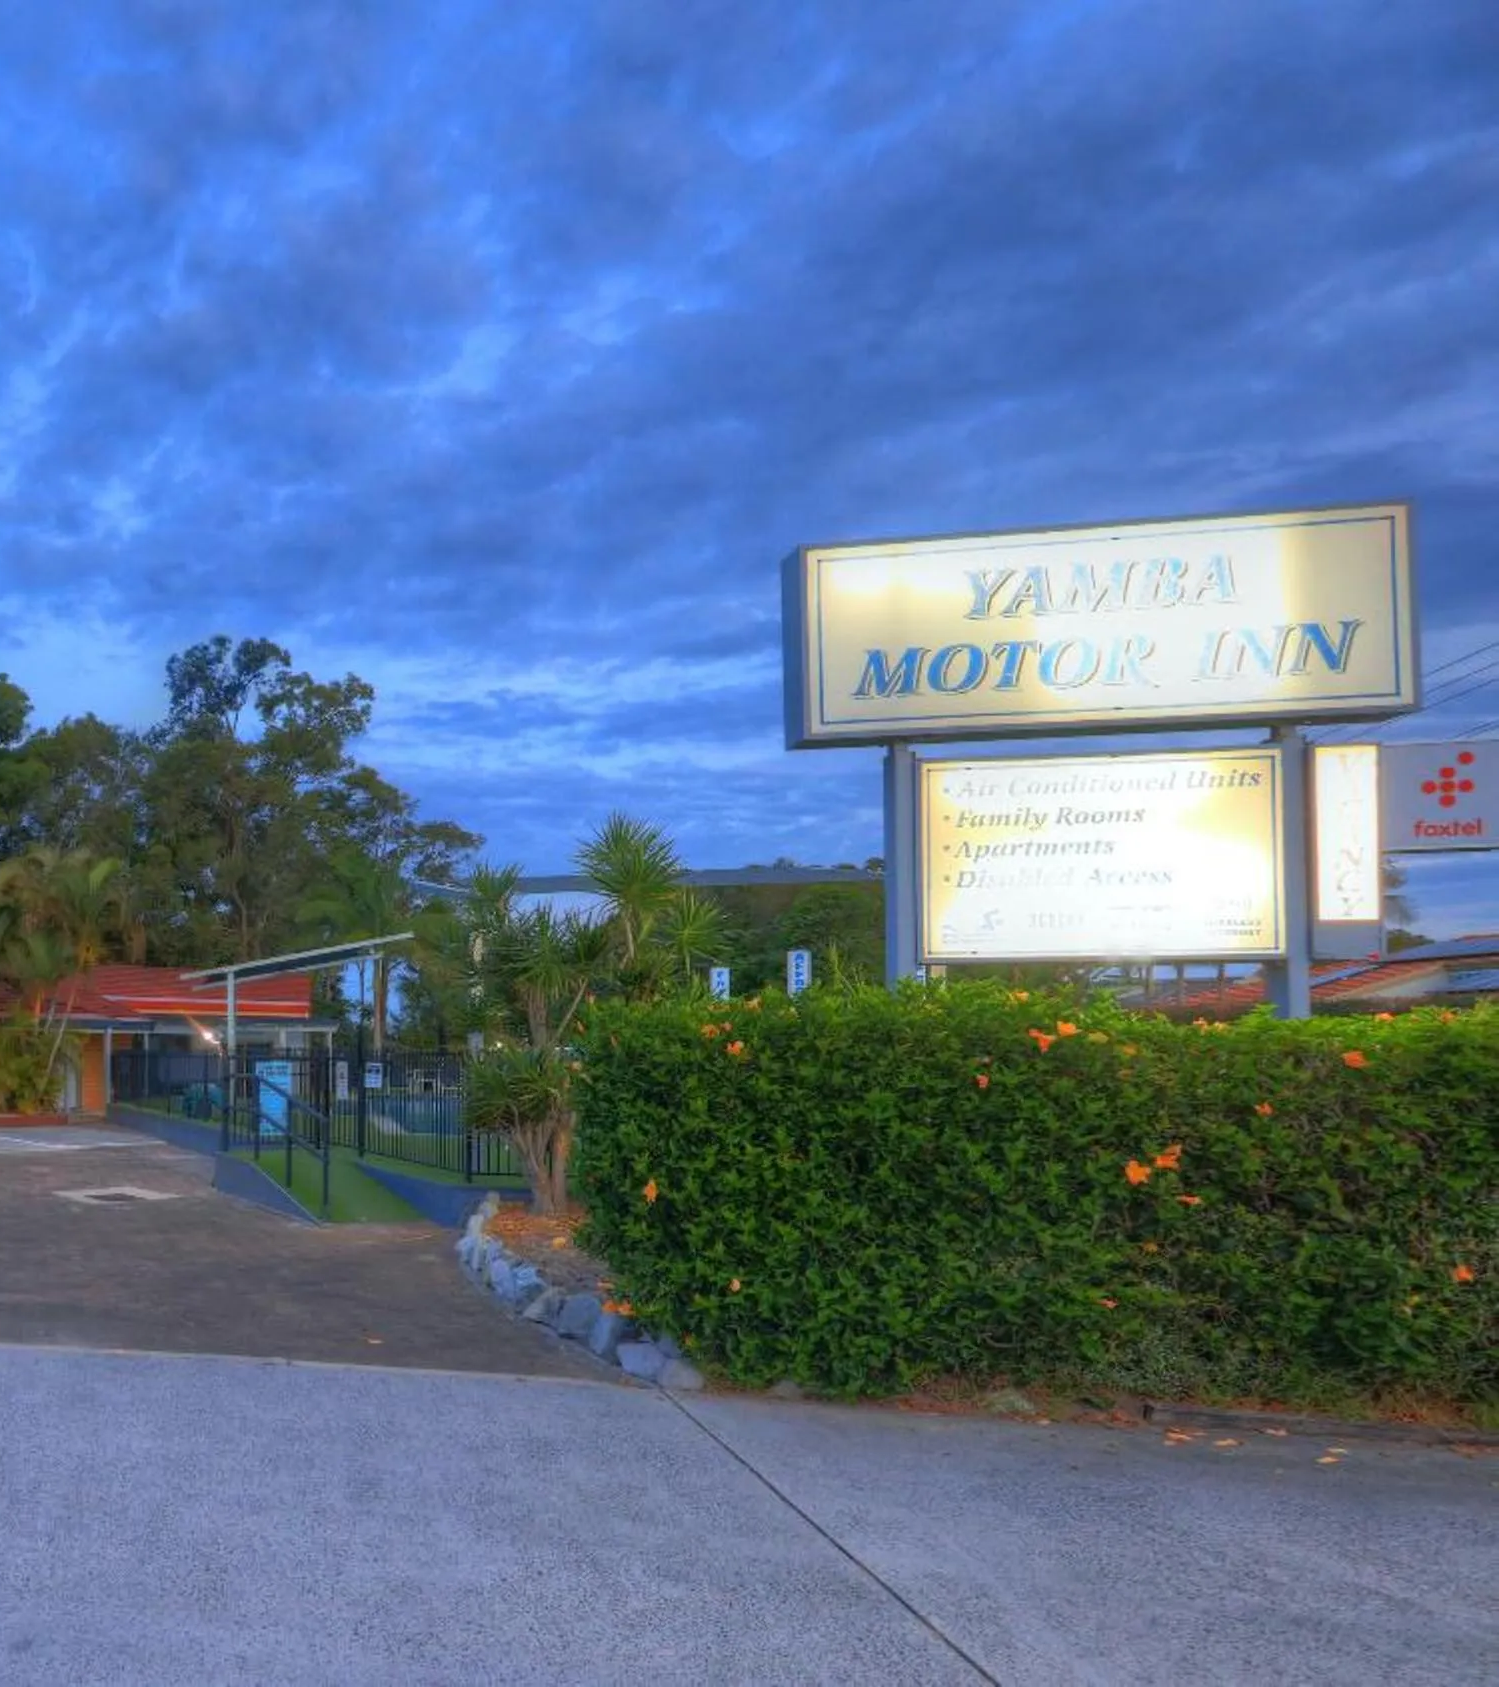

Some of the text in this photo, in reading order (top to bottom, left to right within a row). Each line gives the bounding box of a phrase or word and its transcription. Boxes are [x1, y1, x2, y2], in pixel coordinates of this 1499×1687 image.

[963, 553, 1240, 620] YAMBA
[851, 618, 1365, 700] MOTOR INN
[957, 768, 1262, 798] Air Conditioned Units
[955, 805, 1146, 832] Family Rooms
[1413, 816, 1483, 838] foxtel
[954, 839, 1115, 864] Apartments
